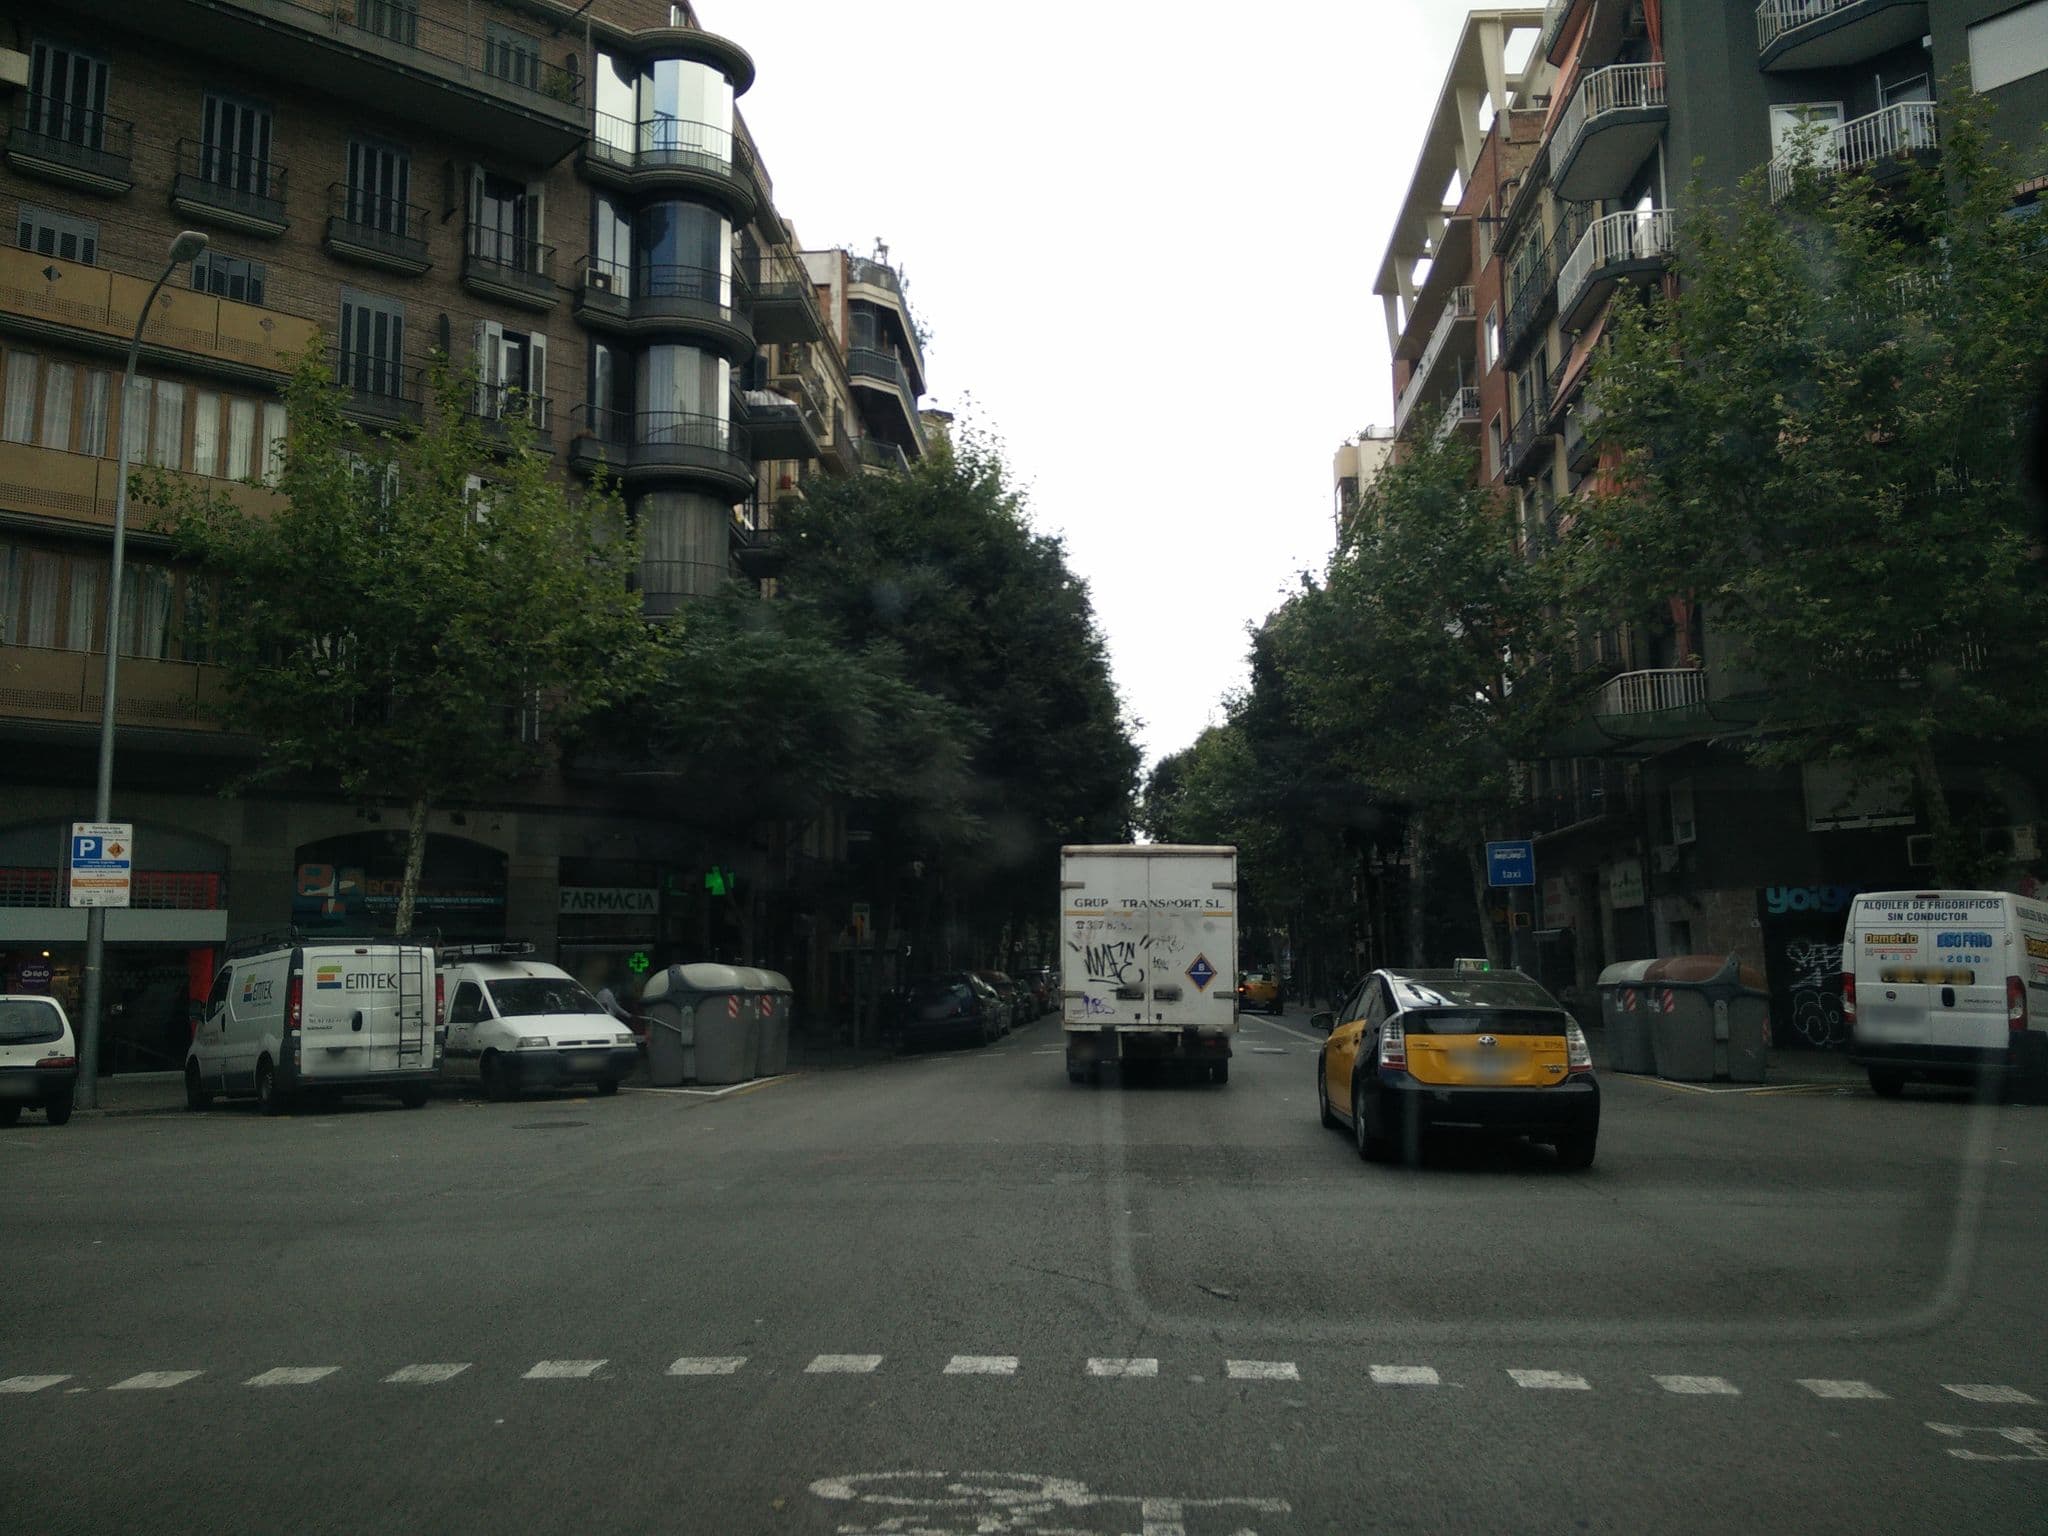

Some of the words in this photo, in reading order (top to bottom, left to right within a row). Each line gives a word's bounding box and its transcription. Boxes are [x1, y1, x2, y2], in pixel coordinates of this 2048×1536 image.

[79, 839, 96, 857] P
[1502, 869, 1521, 879] taxi
[1074, 898, 1109, 908] GRUP
[1863, 900, 1909, 910] ALQUILER
[1912, 900, 1925, 909] DE
[1887, 912, 1905, 921] SIN
[1906, 912, 1968, 921] CONDUCTOR
[1864, 932, 1919, 944] Demetrio
[345, 972, 398, 990] EMTEK
[252, 980, 274, 1001] EMTEK
